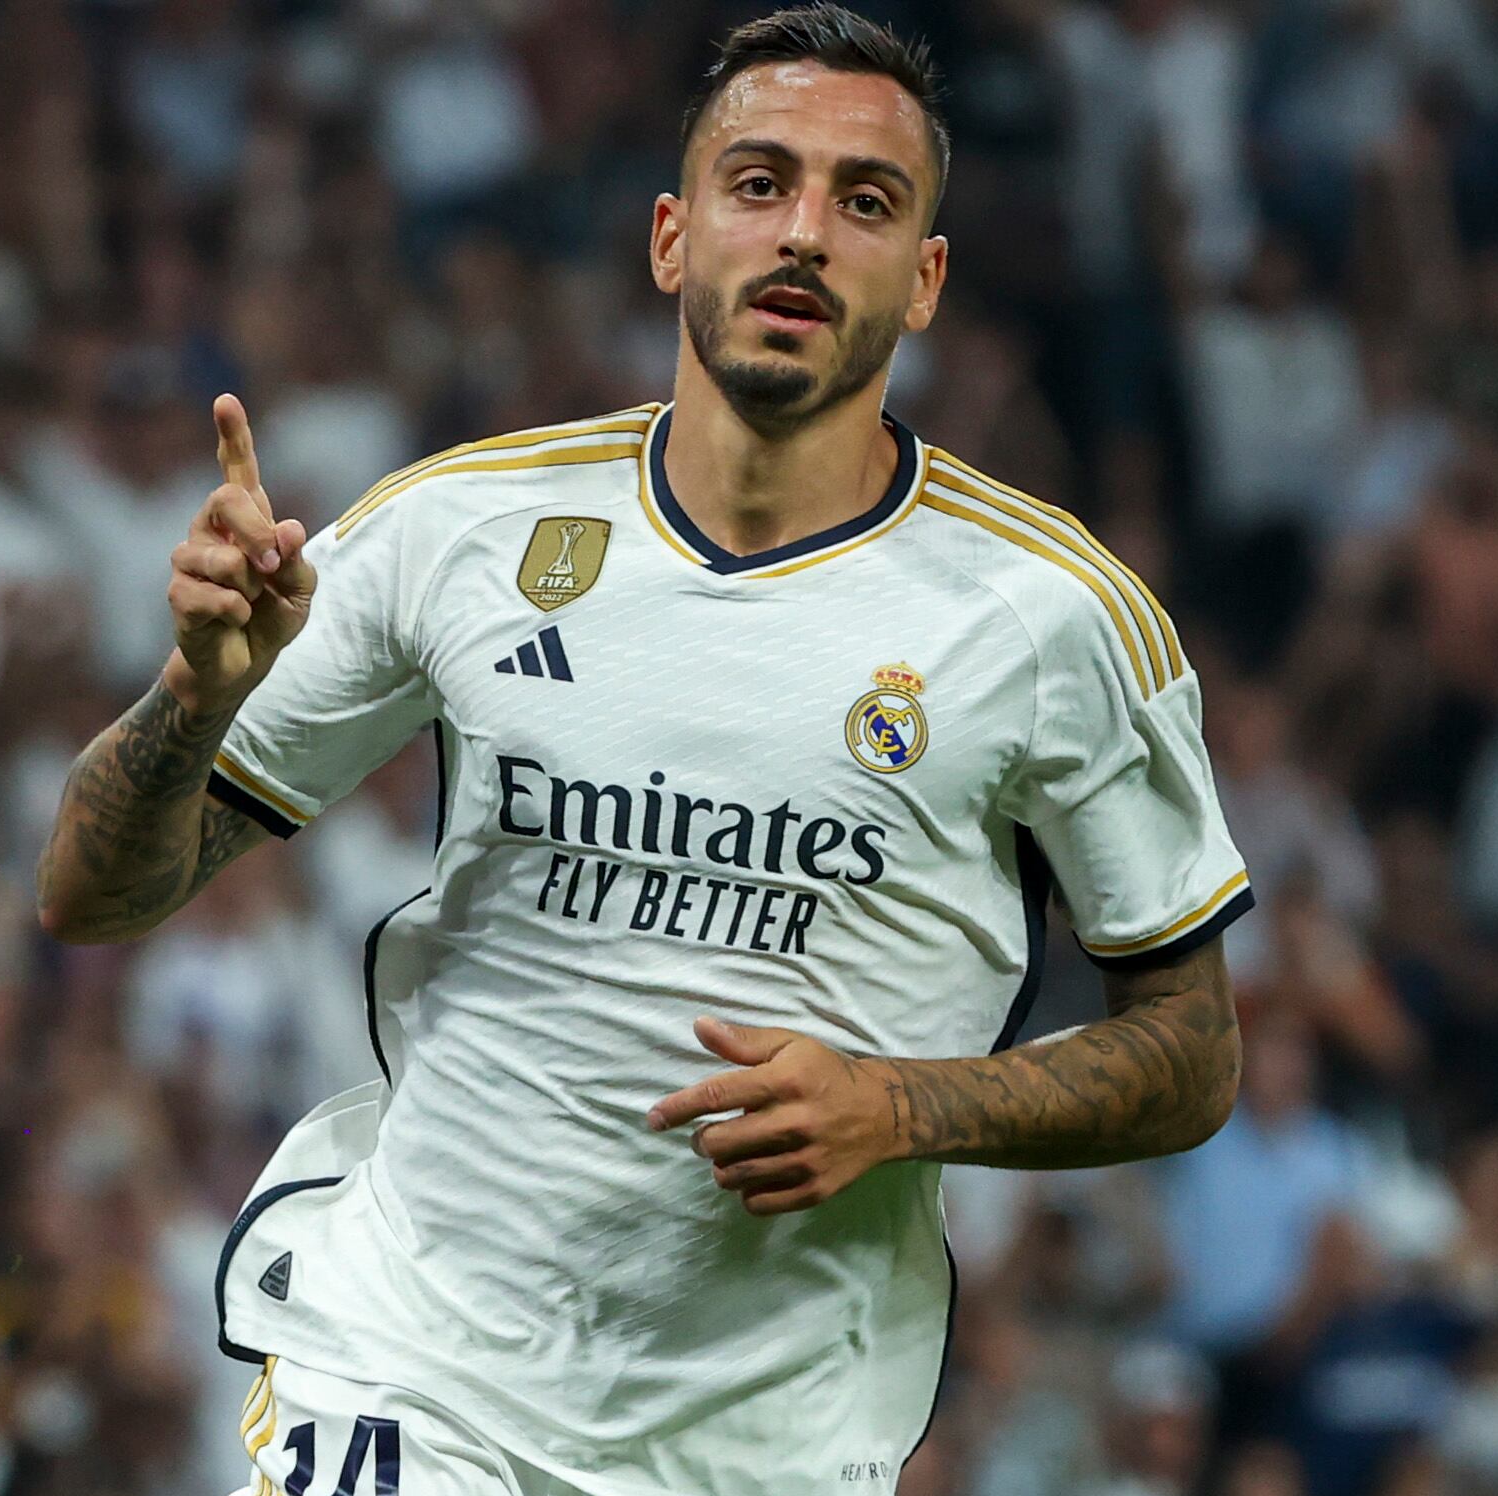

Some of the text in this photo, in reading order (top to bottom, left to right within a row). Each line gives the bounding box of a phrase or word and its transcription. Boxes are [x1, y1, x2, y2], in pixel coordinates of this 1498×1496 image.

[536, 576, 575, 589] FIFA
[497, 754, 886, 885] Emirates
[538, 852, 818, 955] FLY BETTER
